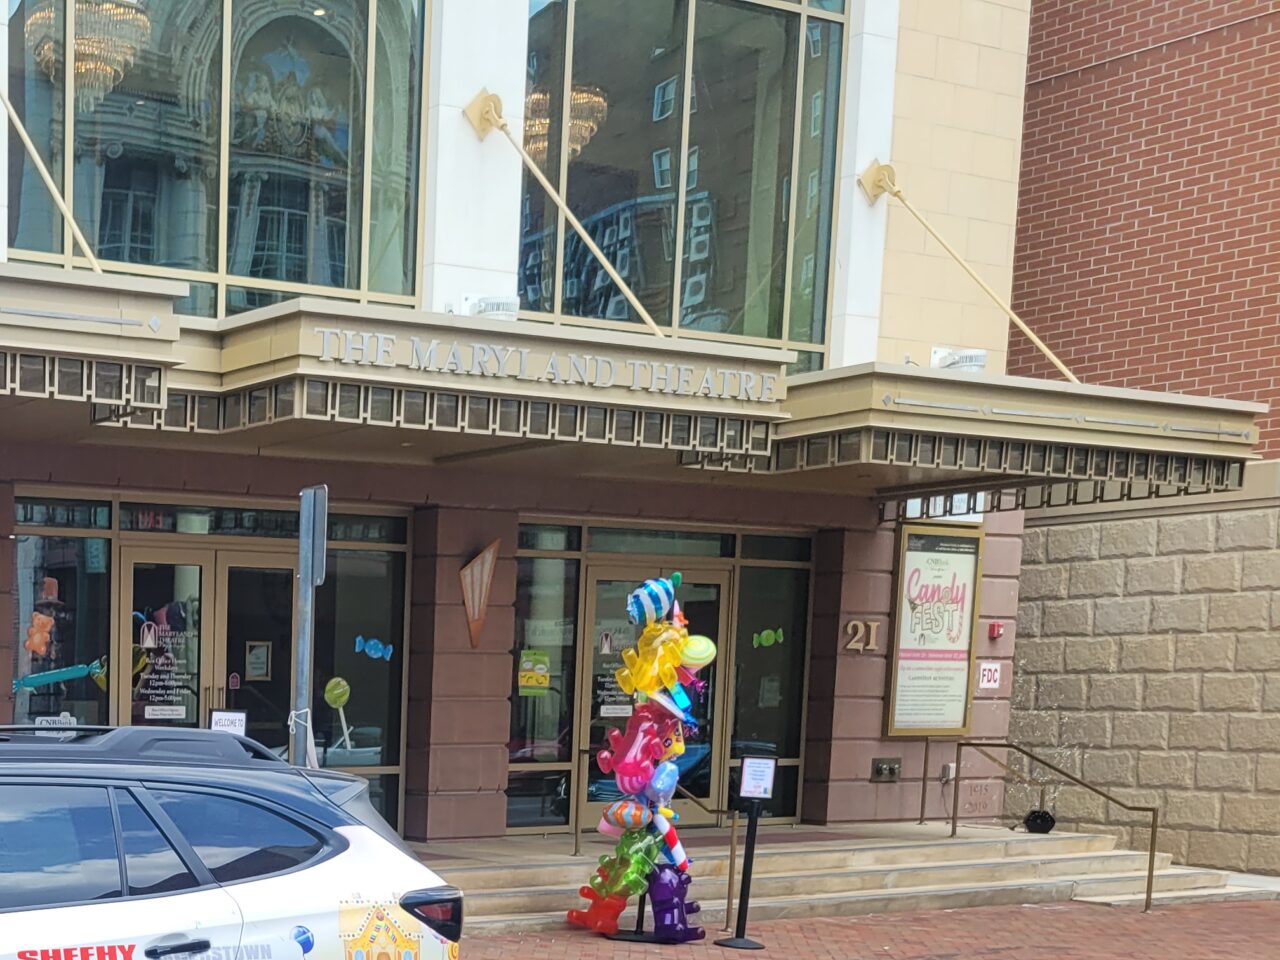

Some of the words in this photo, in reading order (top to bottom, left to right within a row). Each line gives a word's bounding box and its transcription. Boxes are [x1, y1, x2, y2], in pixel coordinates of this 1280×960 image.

[315, 328, 397, 367] THE
[408, 336, 617, 389] MARYLAND
[626, 359, 782, 403] THEATRE
[907, 568, 966, 608] Candy
[910, 601, 958, 634] FEST
[846, 620, 881, 654] 21
[981, 668, 999, 684] FDC
